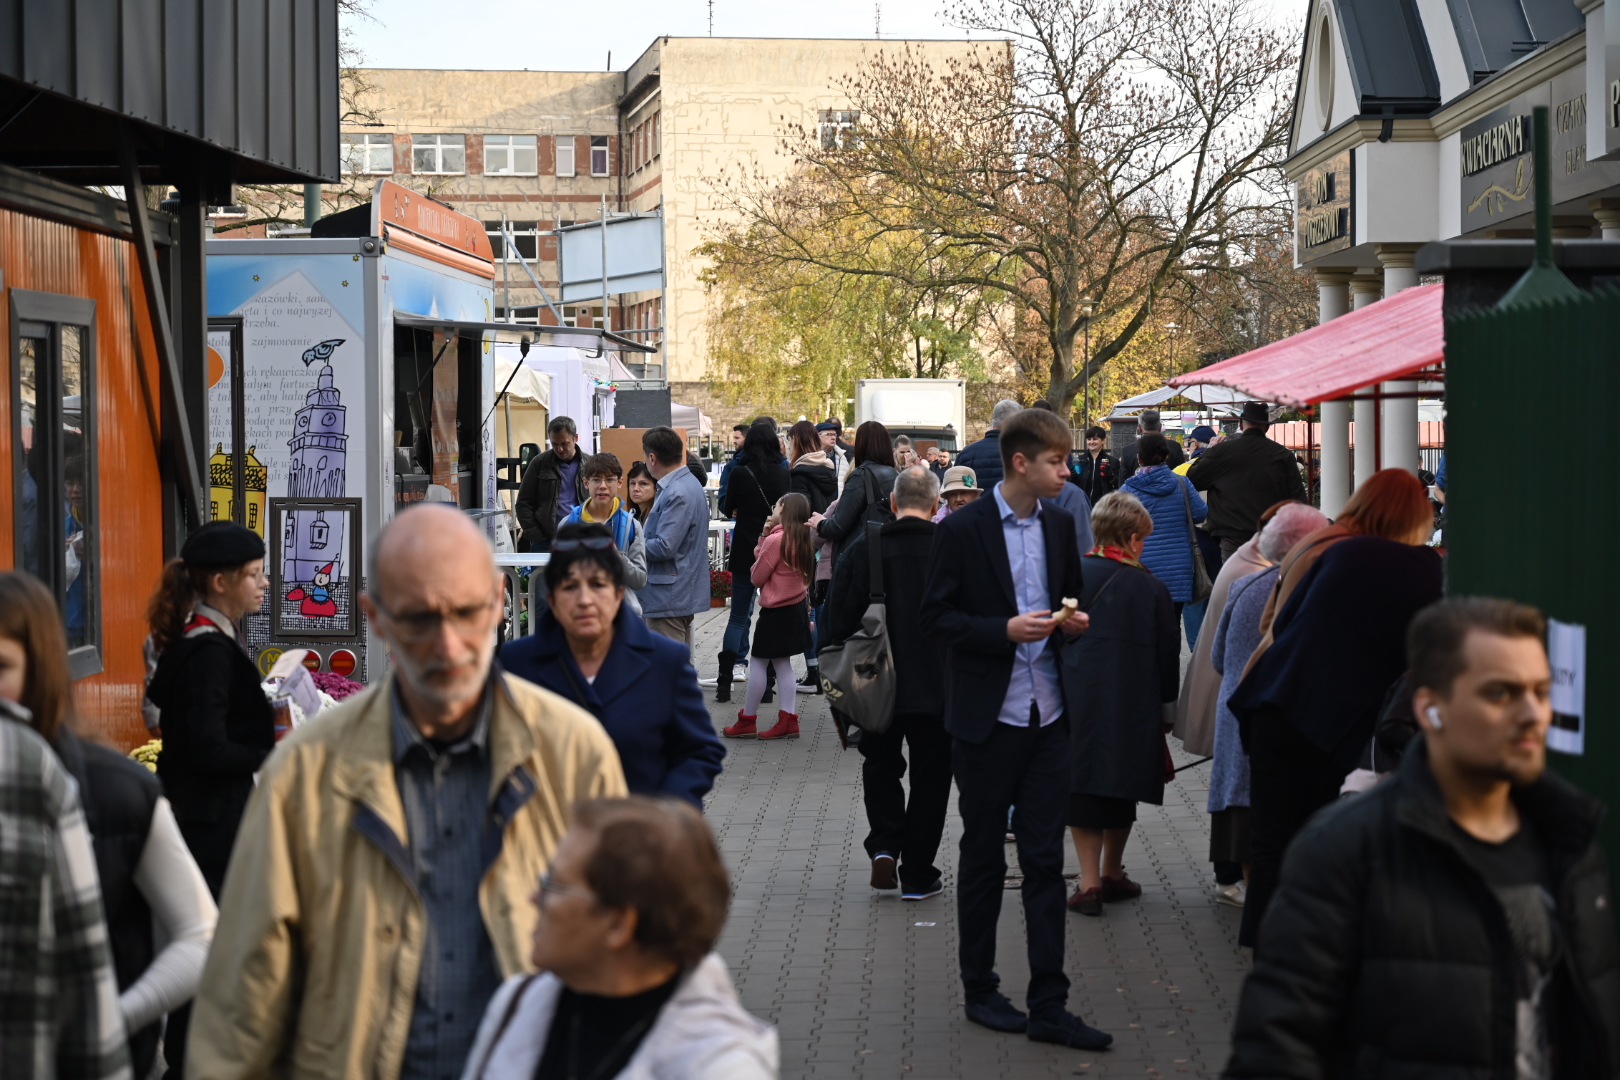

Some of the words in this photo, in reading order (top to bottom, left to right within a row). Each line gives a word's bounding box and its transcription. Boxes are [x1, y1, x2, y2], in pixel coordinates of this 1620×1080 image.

[253, 291, 301, 304] kazówki,
[272, 307, 283, 315] co
[243, 316, 280, 328] trzeba.
[251, 335, 312, 349] zajmowanie
[260, 389, 278, 404] aby
[269, 406, 292, 416] przy
